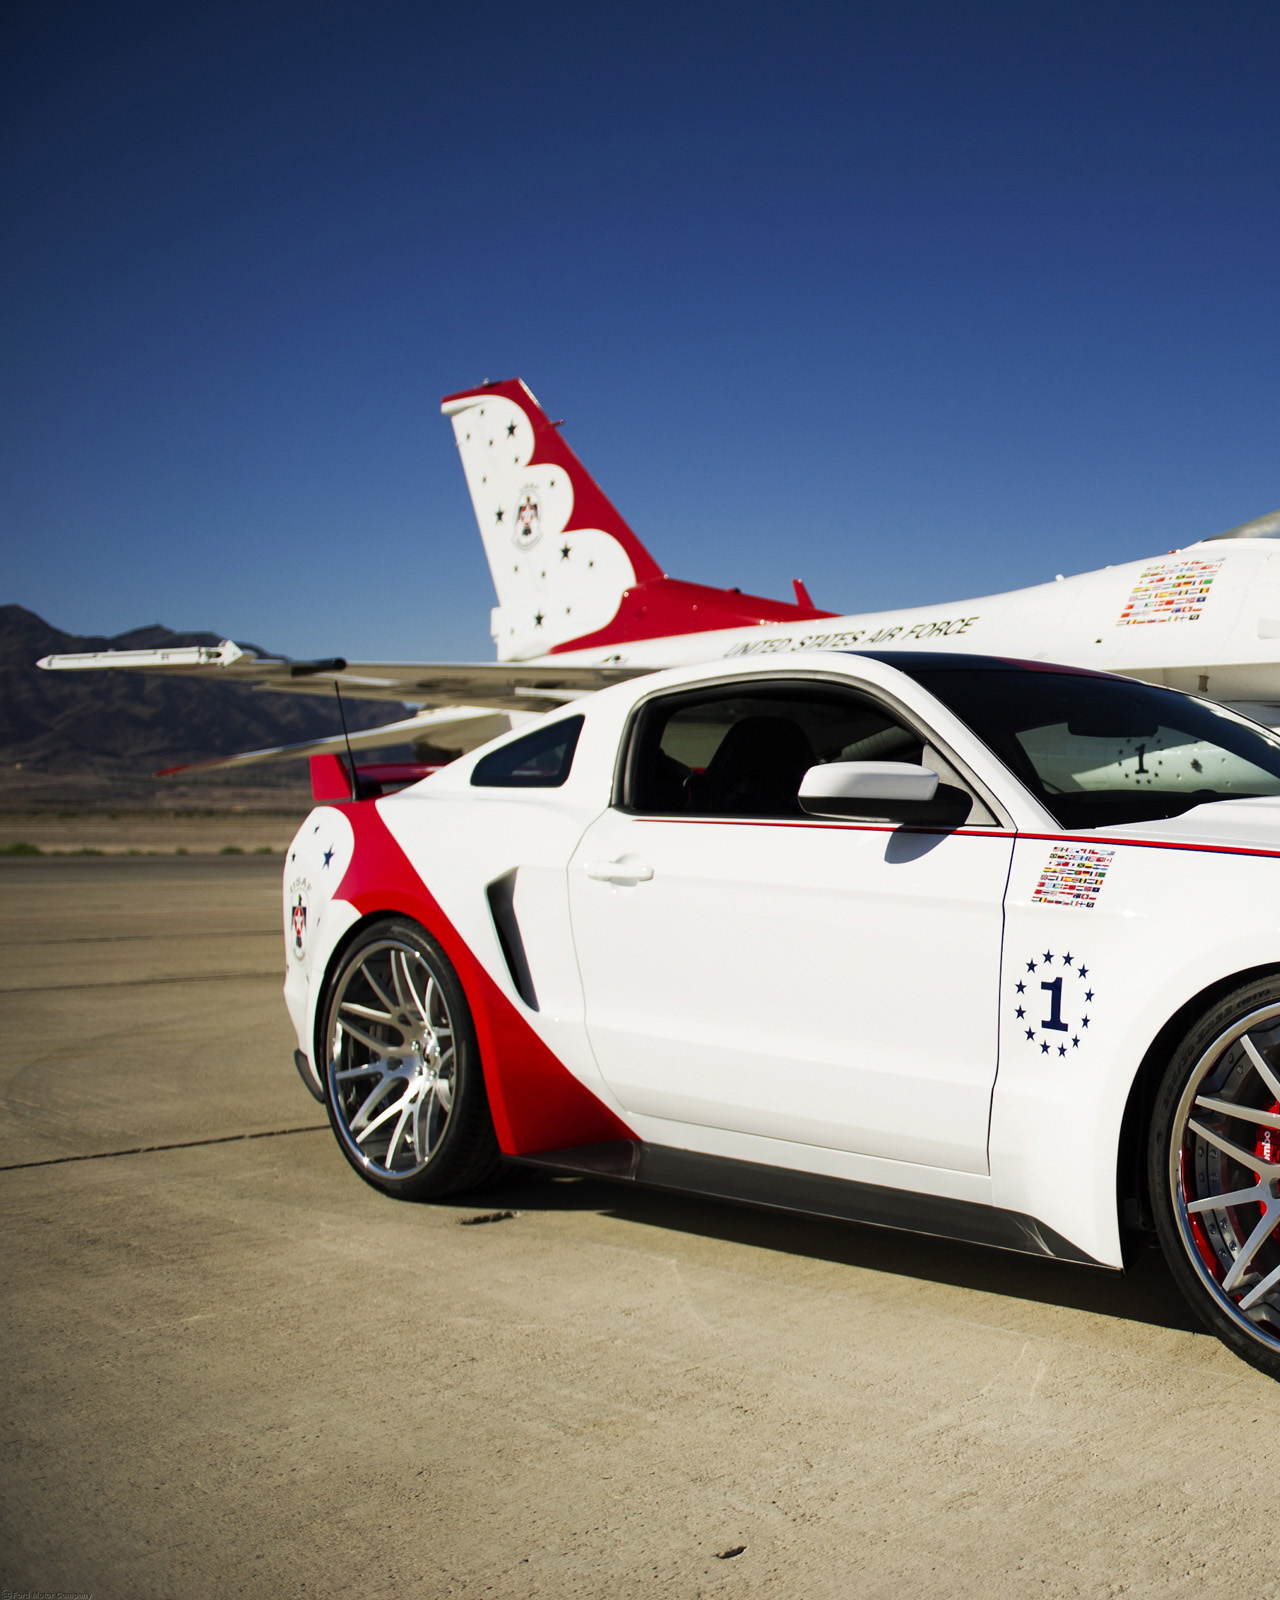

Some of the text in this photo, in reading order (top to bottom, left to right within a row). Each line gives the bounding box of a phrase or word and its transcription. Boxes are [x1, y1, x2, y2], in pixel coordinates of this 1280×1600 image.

[724, 616, 980, 658] UNITED STATES AIR FORCE
[1134, 743, 1149, 774] 1
[1040, 976, 1069, 1032] 1
